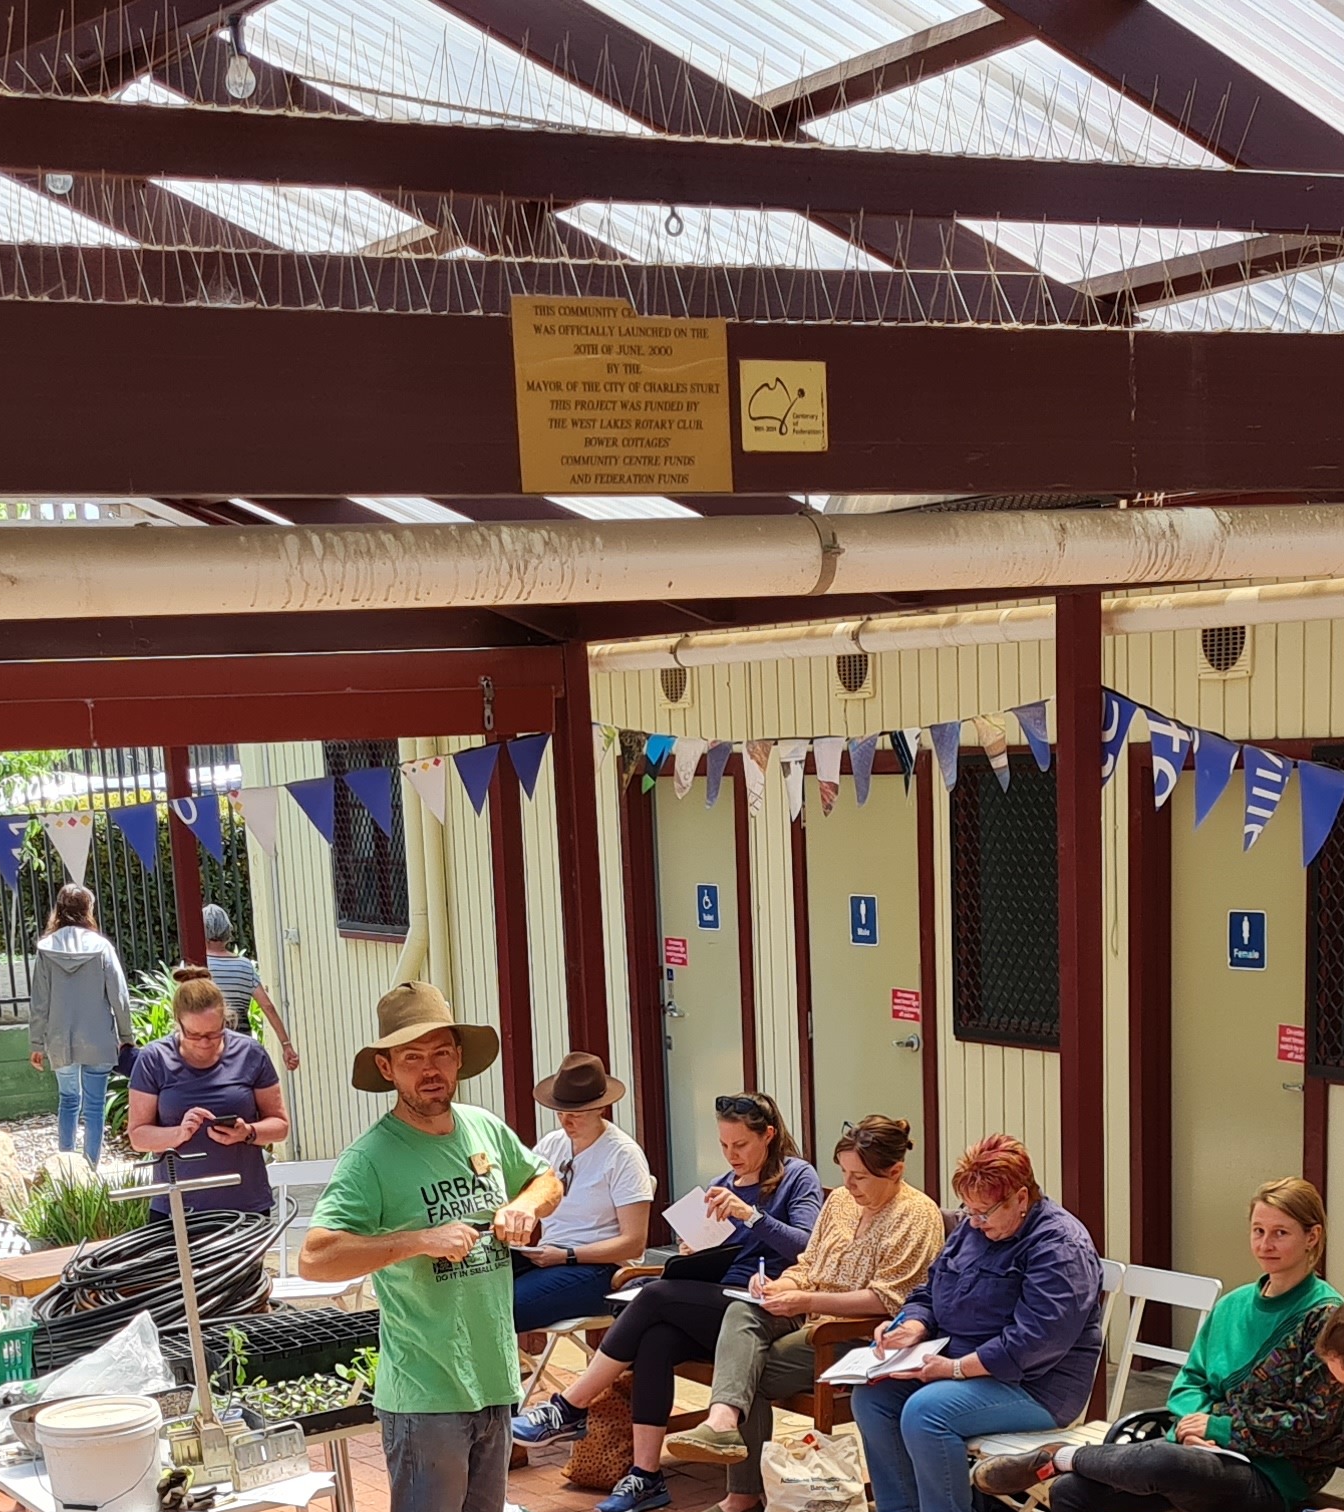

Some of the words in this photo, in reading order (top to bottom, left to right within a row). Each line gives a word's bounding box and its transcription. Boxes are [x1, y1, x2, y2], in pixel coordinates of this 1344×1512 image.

[534, 305, 556, 317] THIS
[558, 306, 618, 318] COMMUNITY
[533, 324, 556, 336] WAS
[558, 325, 617, 337] OFFICIALLY
[619, 326, 672, 338] LAUNCHED
[674, 327, 688, 338] ON
[691, 328, 709, 339] THE
[574, 344, 599, 355] 20TH
[601, 344, 613, 355] OF
[648, 345, 673, 356] 2000
[607, 363, 620, 374] BY
[622, 363, 642, 374] THE
[526, 381, 563, 392] MAYOR
[566, 381, 578, 392] OF
[581, 381, 601, 392] THE
[603, 381, 625, 392] CITY
[628, 382, 640, 392] OF
[643, 382, 688, 394] CHARLES
[690, 383, 721, 394] STURT
[550, 400, 571, 411] THIS
[574, 400, 618, 411] PROJECT
[620, 400, 641, 411] WAS
[644, 400, 684, 412] FUNDED
[686, 401, 700, 412] BY
[548, 418, 567, 429] THE
[571, 418, 597, 429] WEST
[600, 418, 632, 430] LAKES
[634, 419, 674, 430] ROTARY
[584, 437, 618, 448] BOWER
[560, 455, 619, 466] COMMUNITY
[622, 455, 661, 467] CENTRE
[664, 456, 695, 467] FUNDS
[570, 474, 591, 485] AND
[594, 474, 655, 485] FEDERATION
[658, 474, 689, 485] FUNDS
[1233, 948, 1259, 959] Female
[427, 1191, 505, 1224] FARMERS
[436, 1274, 449, 1283] DO
[449, 1271, 457, 1280] IT
[459, 1269, 468, 1278] IN
